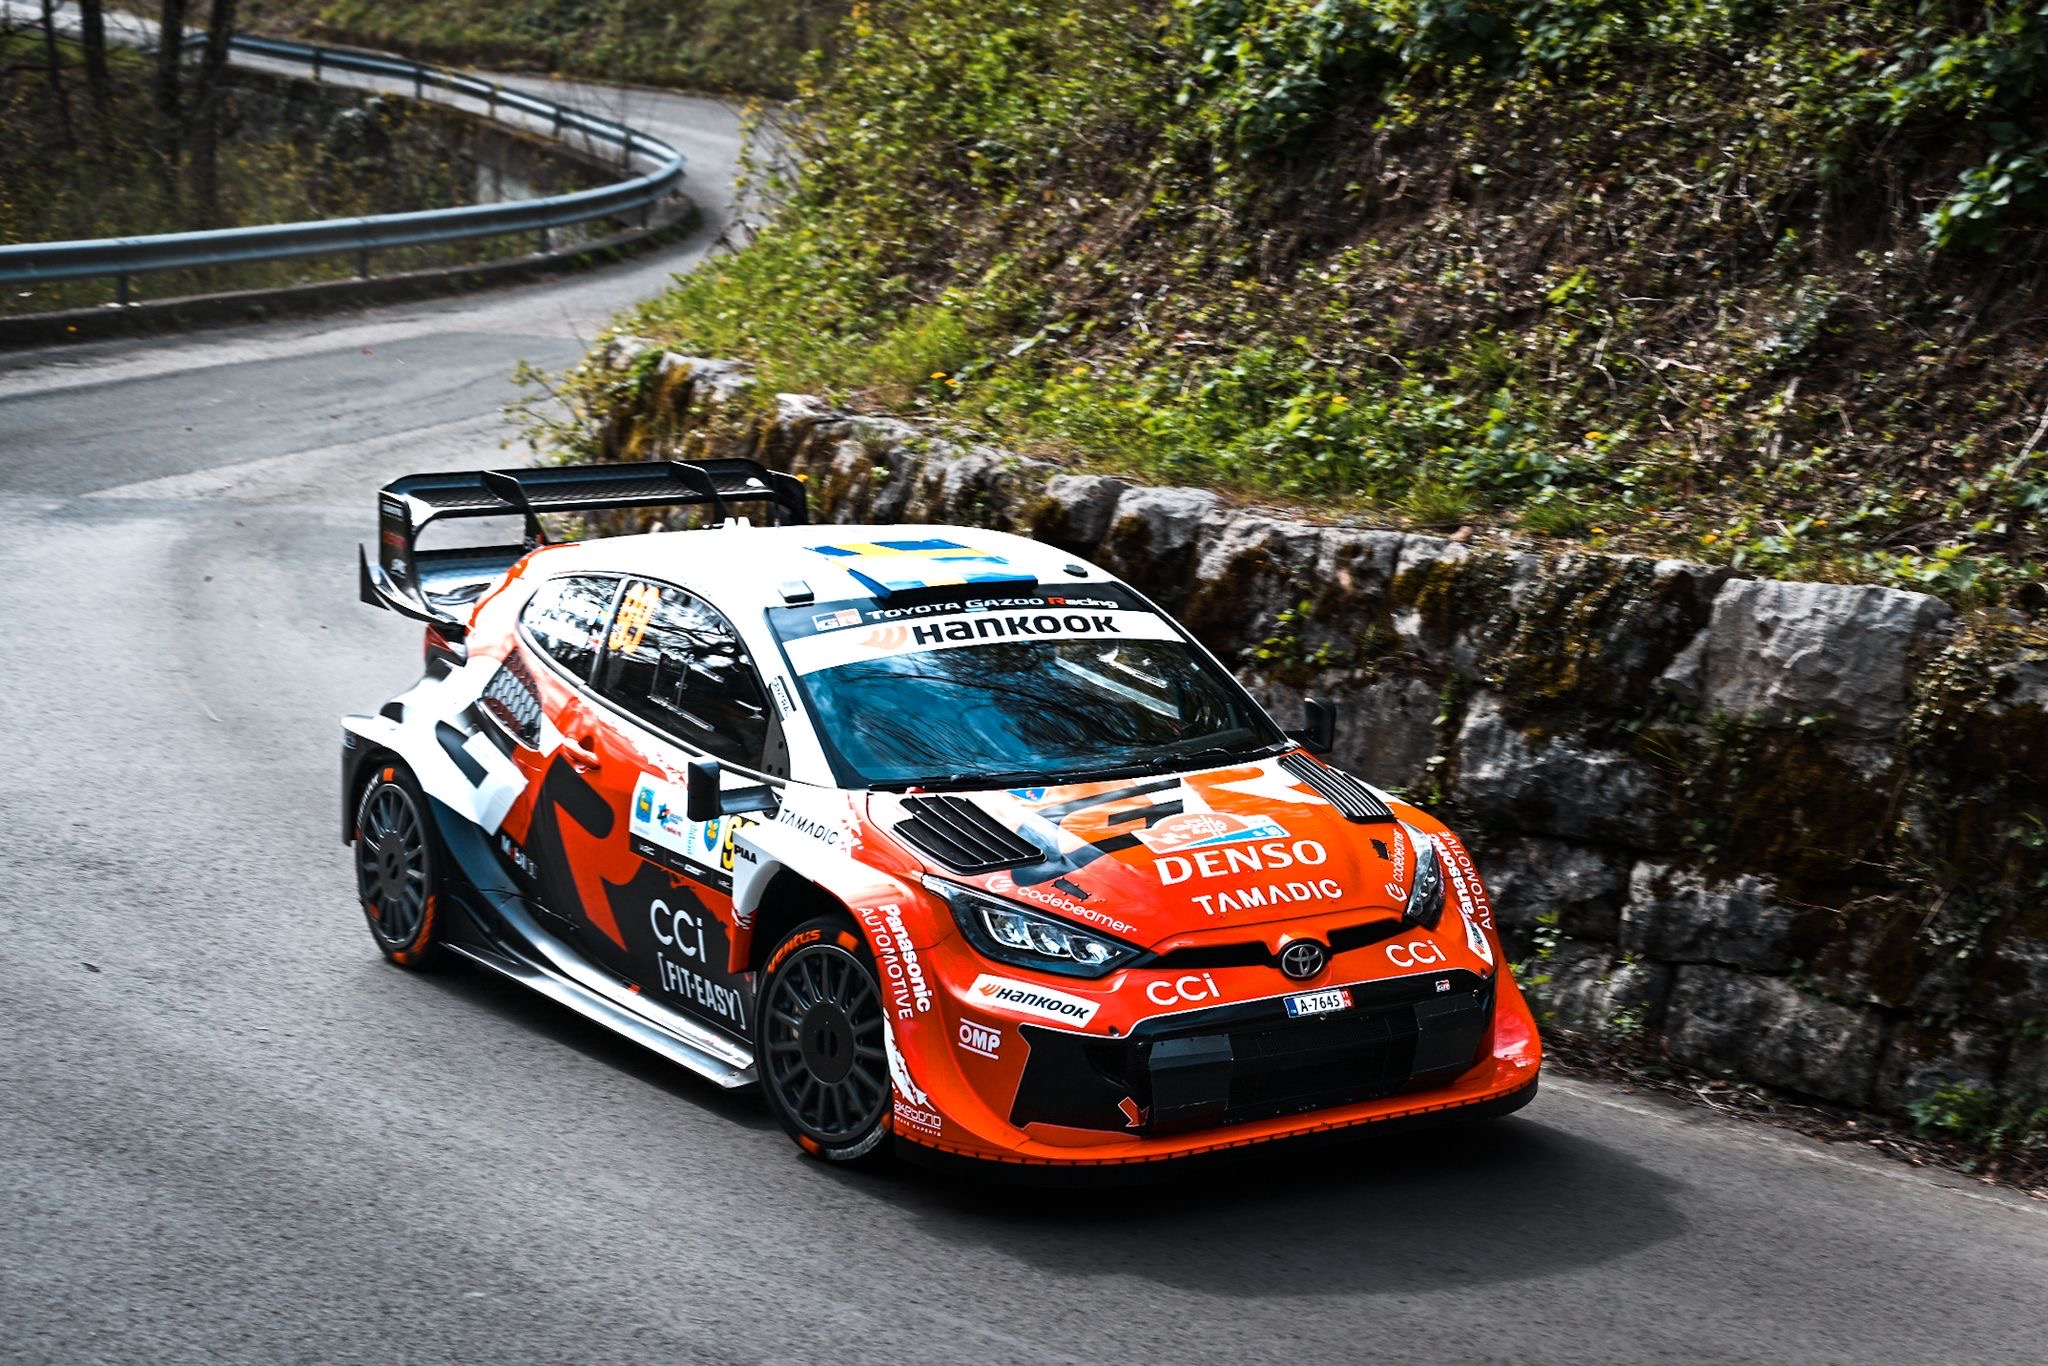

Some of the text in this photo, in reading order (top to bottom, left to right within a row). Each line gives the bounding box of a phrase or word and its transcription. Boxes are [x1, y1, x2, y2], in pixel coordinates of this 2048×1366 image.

[865, 597, 1119, 620] TOYOTA GAZOO Racing
[780, 808, 838, 845] TAMADIC
[735, 845, 757, 864] PIAA
[1153, 839, 1328, 886] DENSO
[1191, 879, 1343, 915] TAMADIC
[1438, 831, 1492, 929] AUTOMOTIVE
[1017, 886, 1134, 934] codebeamer
[650, 898, 706, 963] CCi
[857, 907, 914, 1020] AUTOMOTIVE
[879, 903, 933, 1013] Panasonic
[1385, 939, 1447, 967] CCi
[1146, 972, 1221, 1006] CCi
[1300, 994, 1340, 1012] A-7645
[959, 1024, 1001, 1052] OMP
[894, 1100, 942, 1127] akebono
